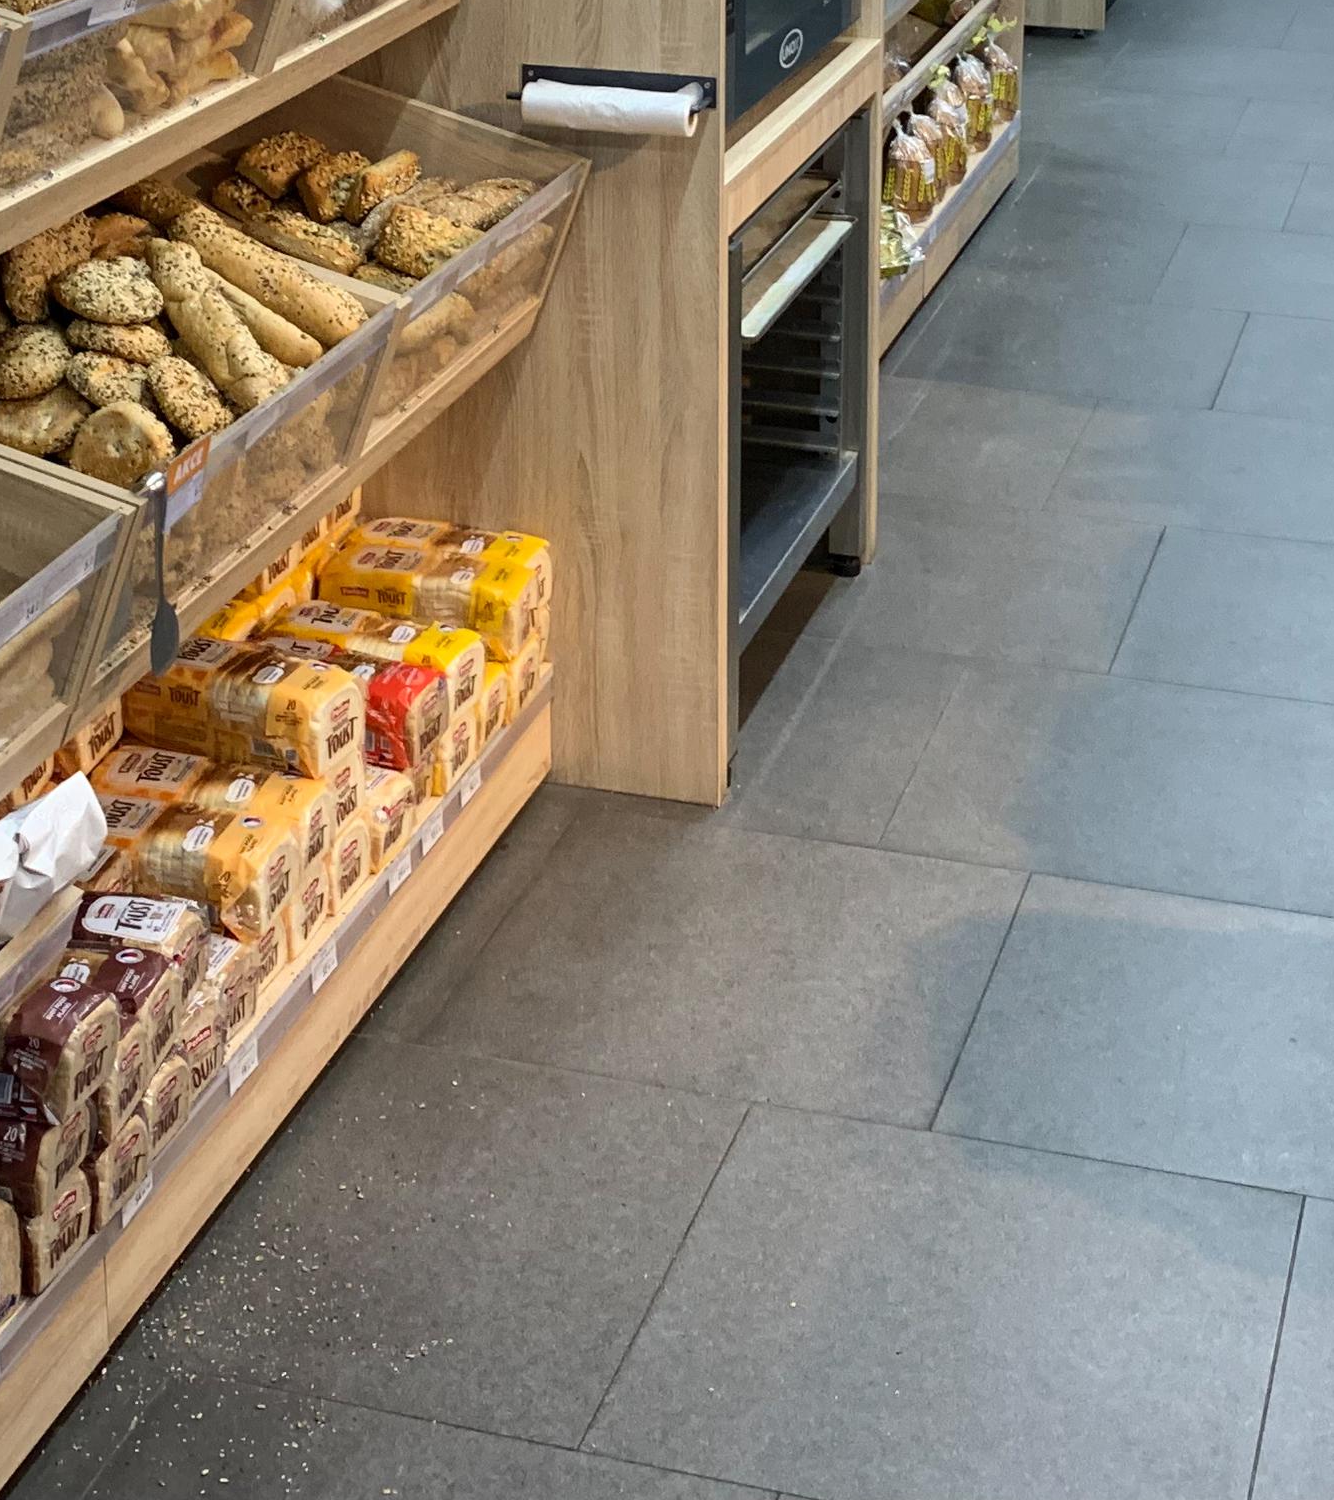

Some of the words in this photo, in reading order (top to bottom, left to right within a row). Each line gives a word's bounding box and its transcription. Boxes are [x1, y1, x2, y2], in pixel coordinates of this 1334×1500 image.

[168, 685, 201, 707] TOUST
[88, 712, 118, 760] TOUST
[326, 716, 359, 759] TOUST
[136, 752, 176, 784] TOUST
[107, 799, 136, 828] OUST
[115, 900, 155, 931] TOUST
[191, 1043, 221, 1089] OUST
[4, 1126, 17, 1142] 20
